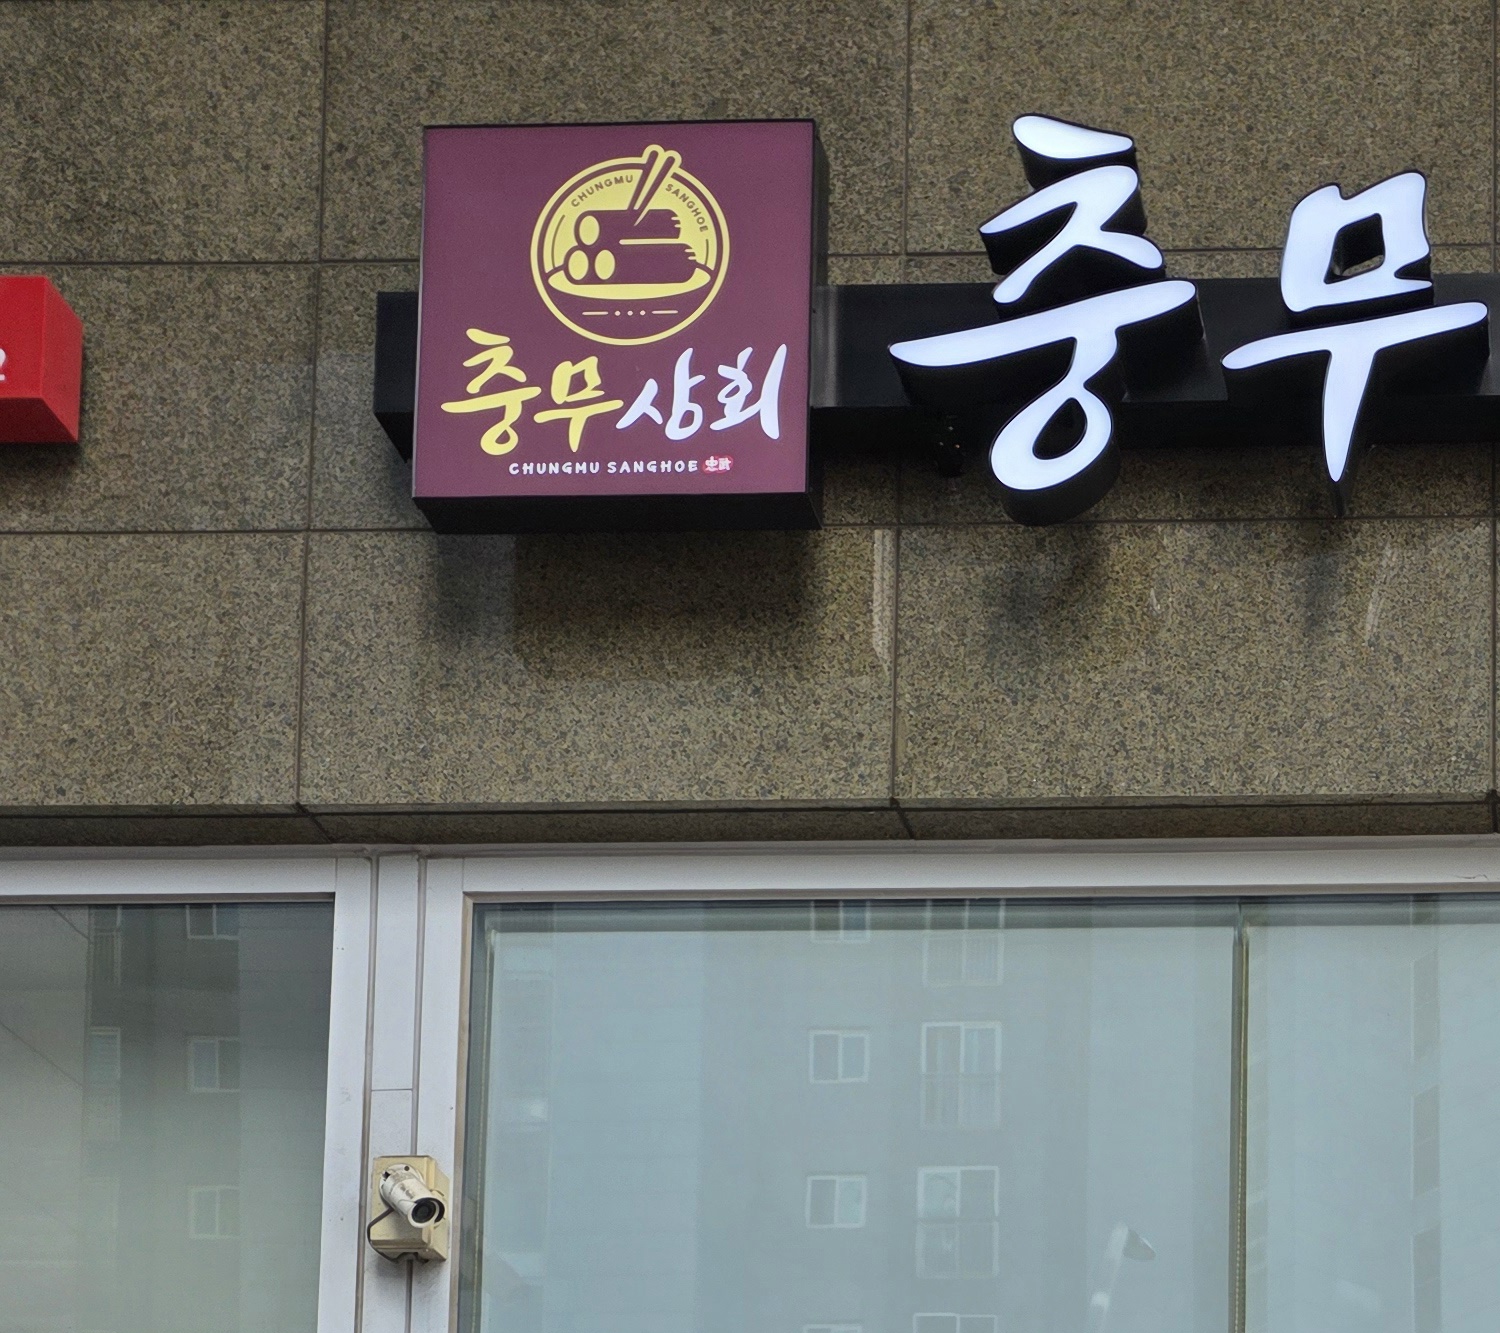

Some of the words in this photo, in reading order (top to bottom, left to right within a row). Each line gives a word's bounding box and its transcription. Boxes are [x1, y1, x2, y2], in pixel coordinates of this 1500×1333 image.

[571, 174, 634, 208] CHUNGMU
[665, 183, 709, 233] SANGHOE
[440, 328, 788, 456] 충무상회
[508, 461, 601, 476] CHUNGMU
[606, 459, 699, 475] SANGHOE
